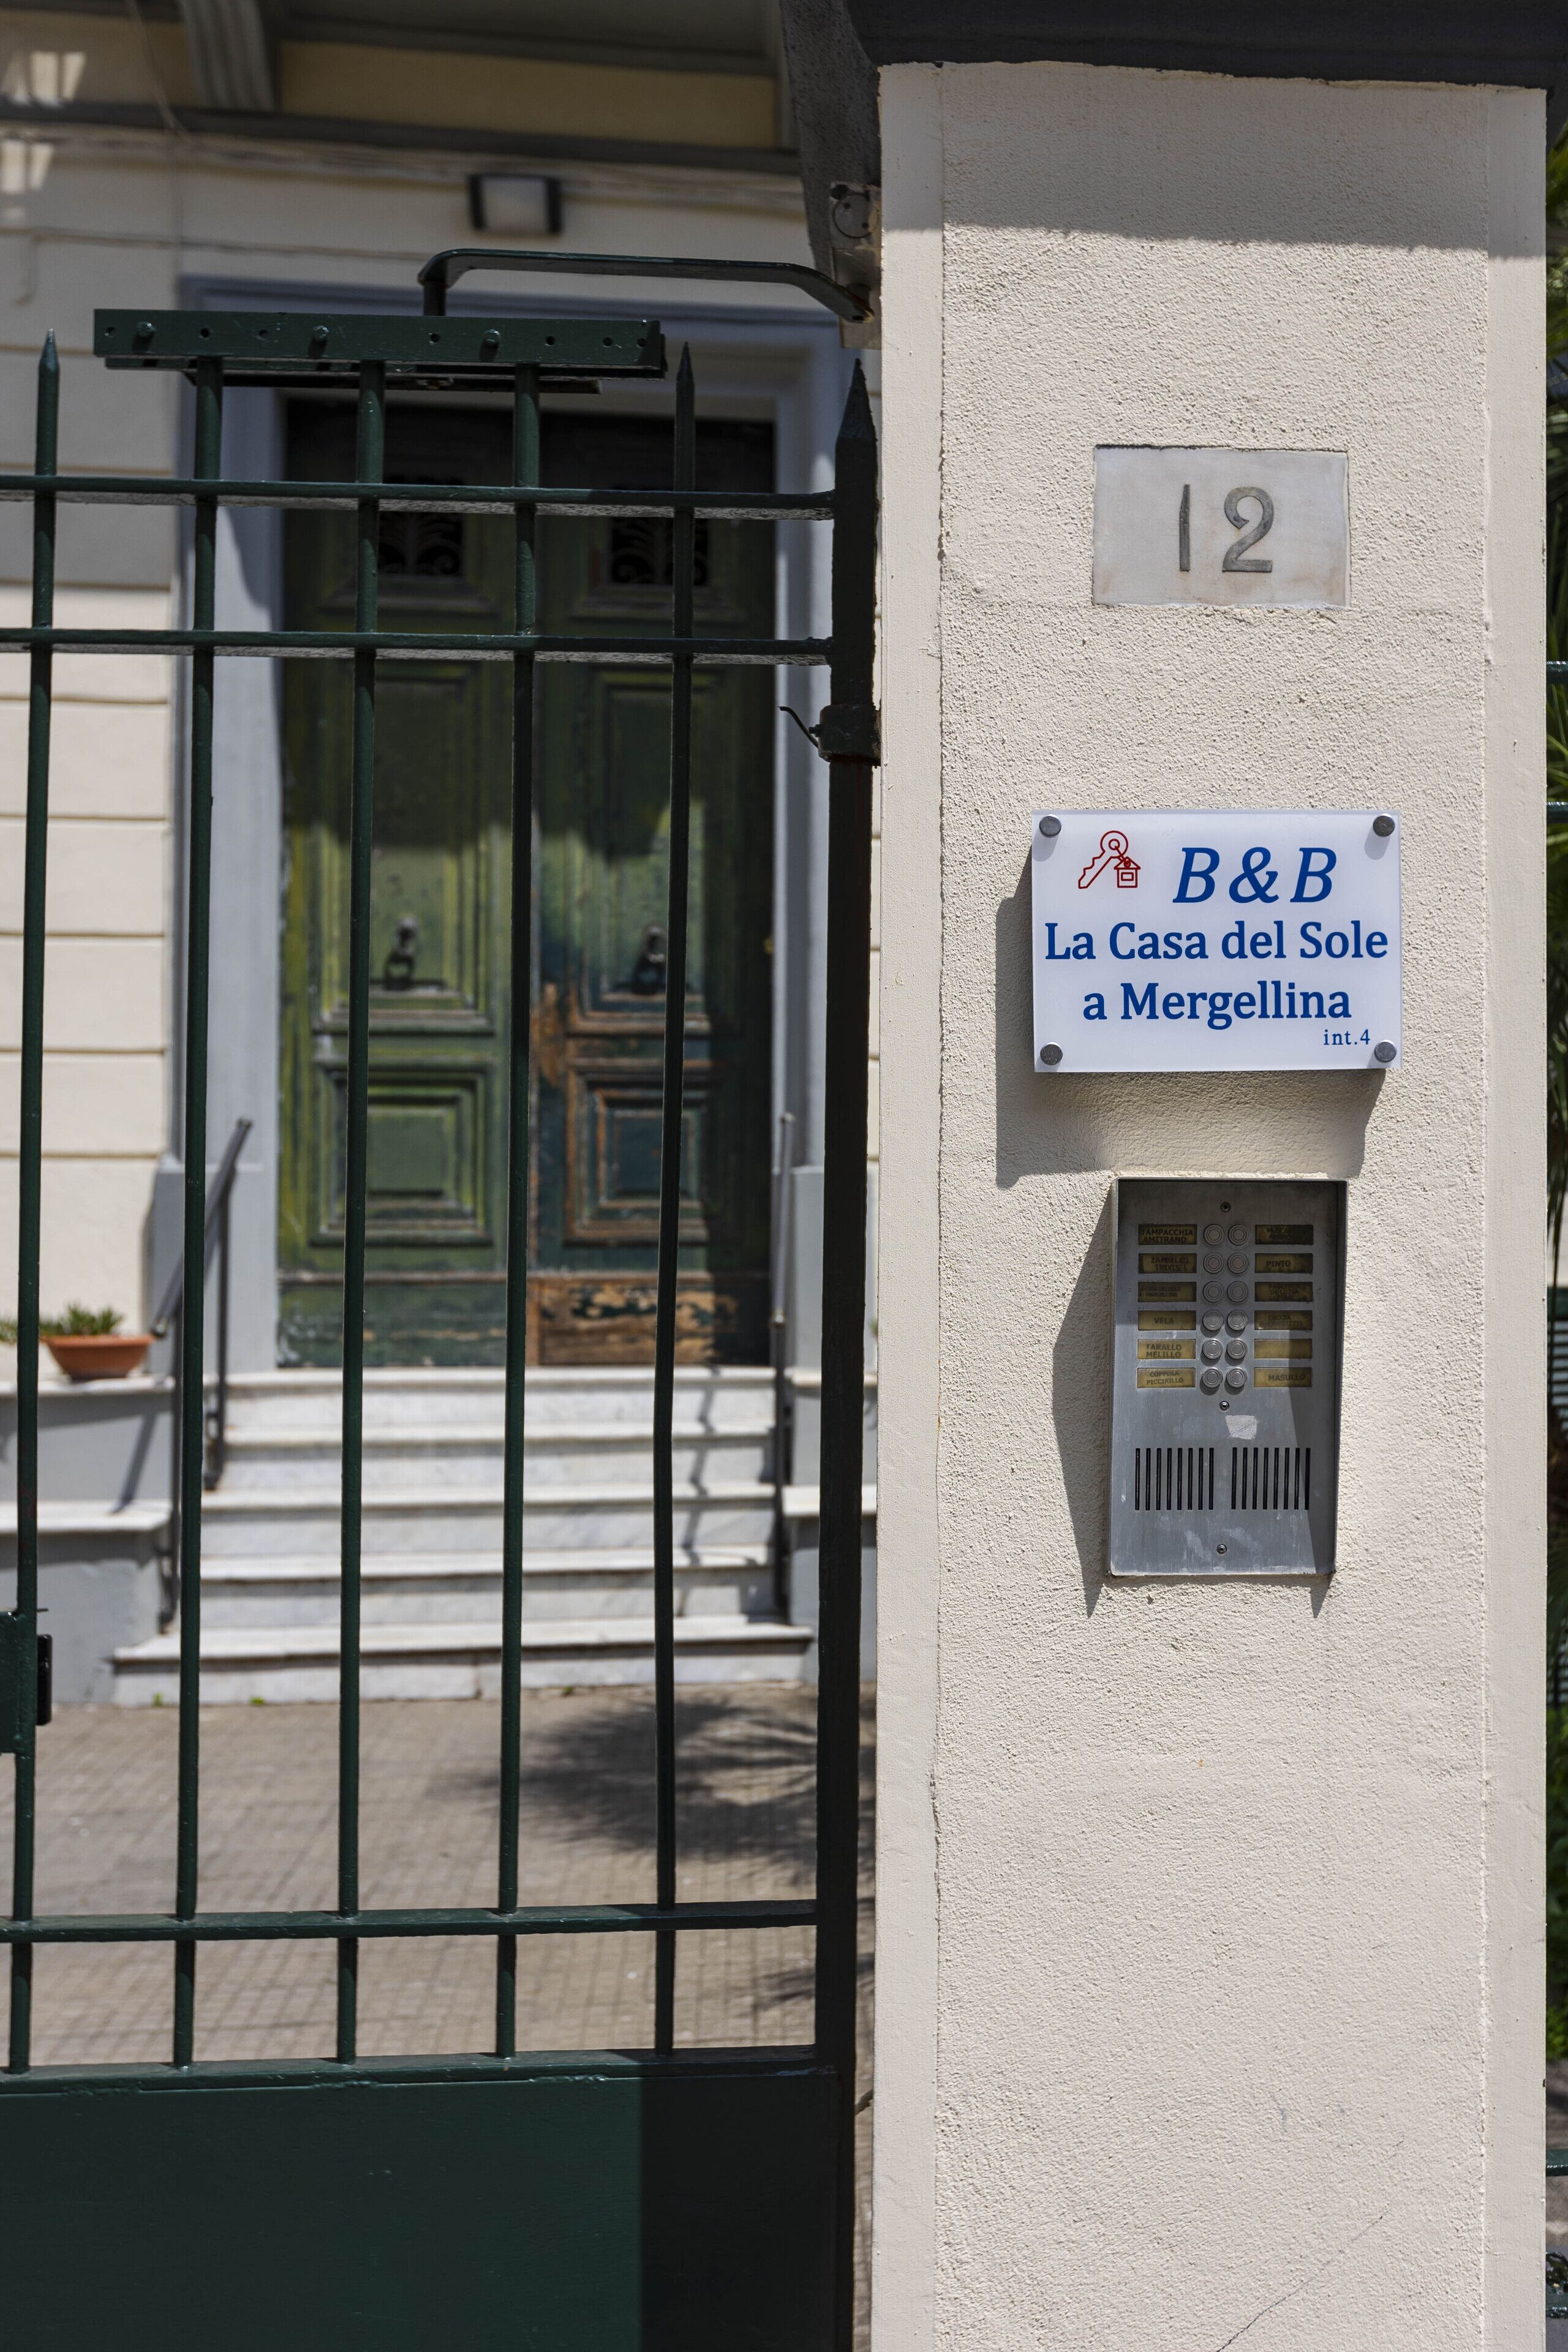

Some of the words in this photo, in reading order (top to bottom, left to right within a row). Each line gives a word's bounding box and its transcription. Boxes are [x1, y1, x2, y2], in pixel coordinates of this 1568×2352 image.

[1179, 484, 1274, 573] 12
[1172, 846, 1337, 905] B&B
[1044, 922, 1096, 960] La
[1109, 922, 1209, 960] Casa
[1221, 919, 1287, 960] del
[1299, 919, 1389, 959] Sole
[1082, 992, 1107, 1021] a
[1120, 980, 1352, 1030] Mergellina
[1324, 1029, 1370, 1046] int.4
